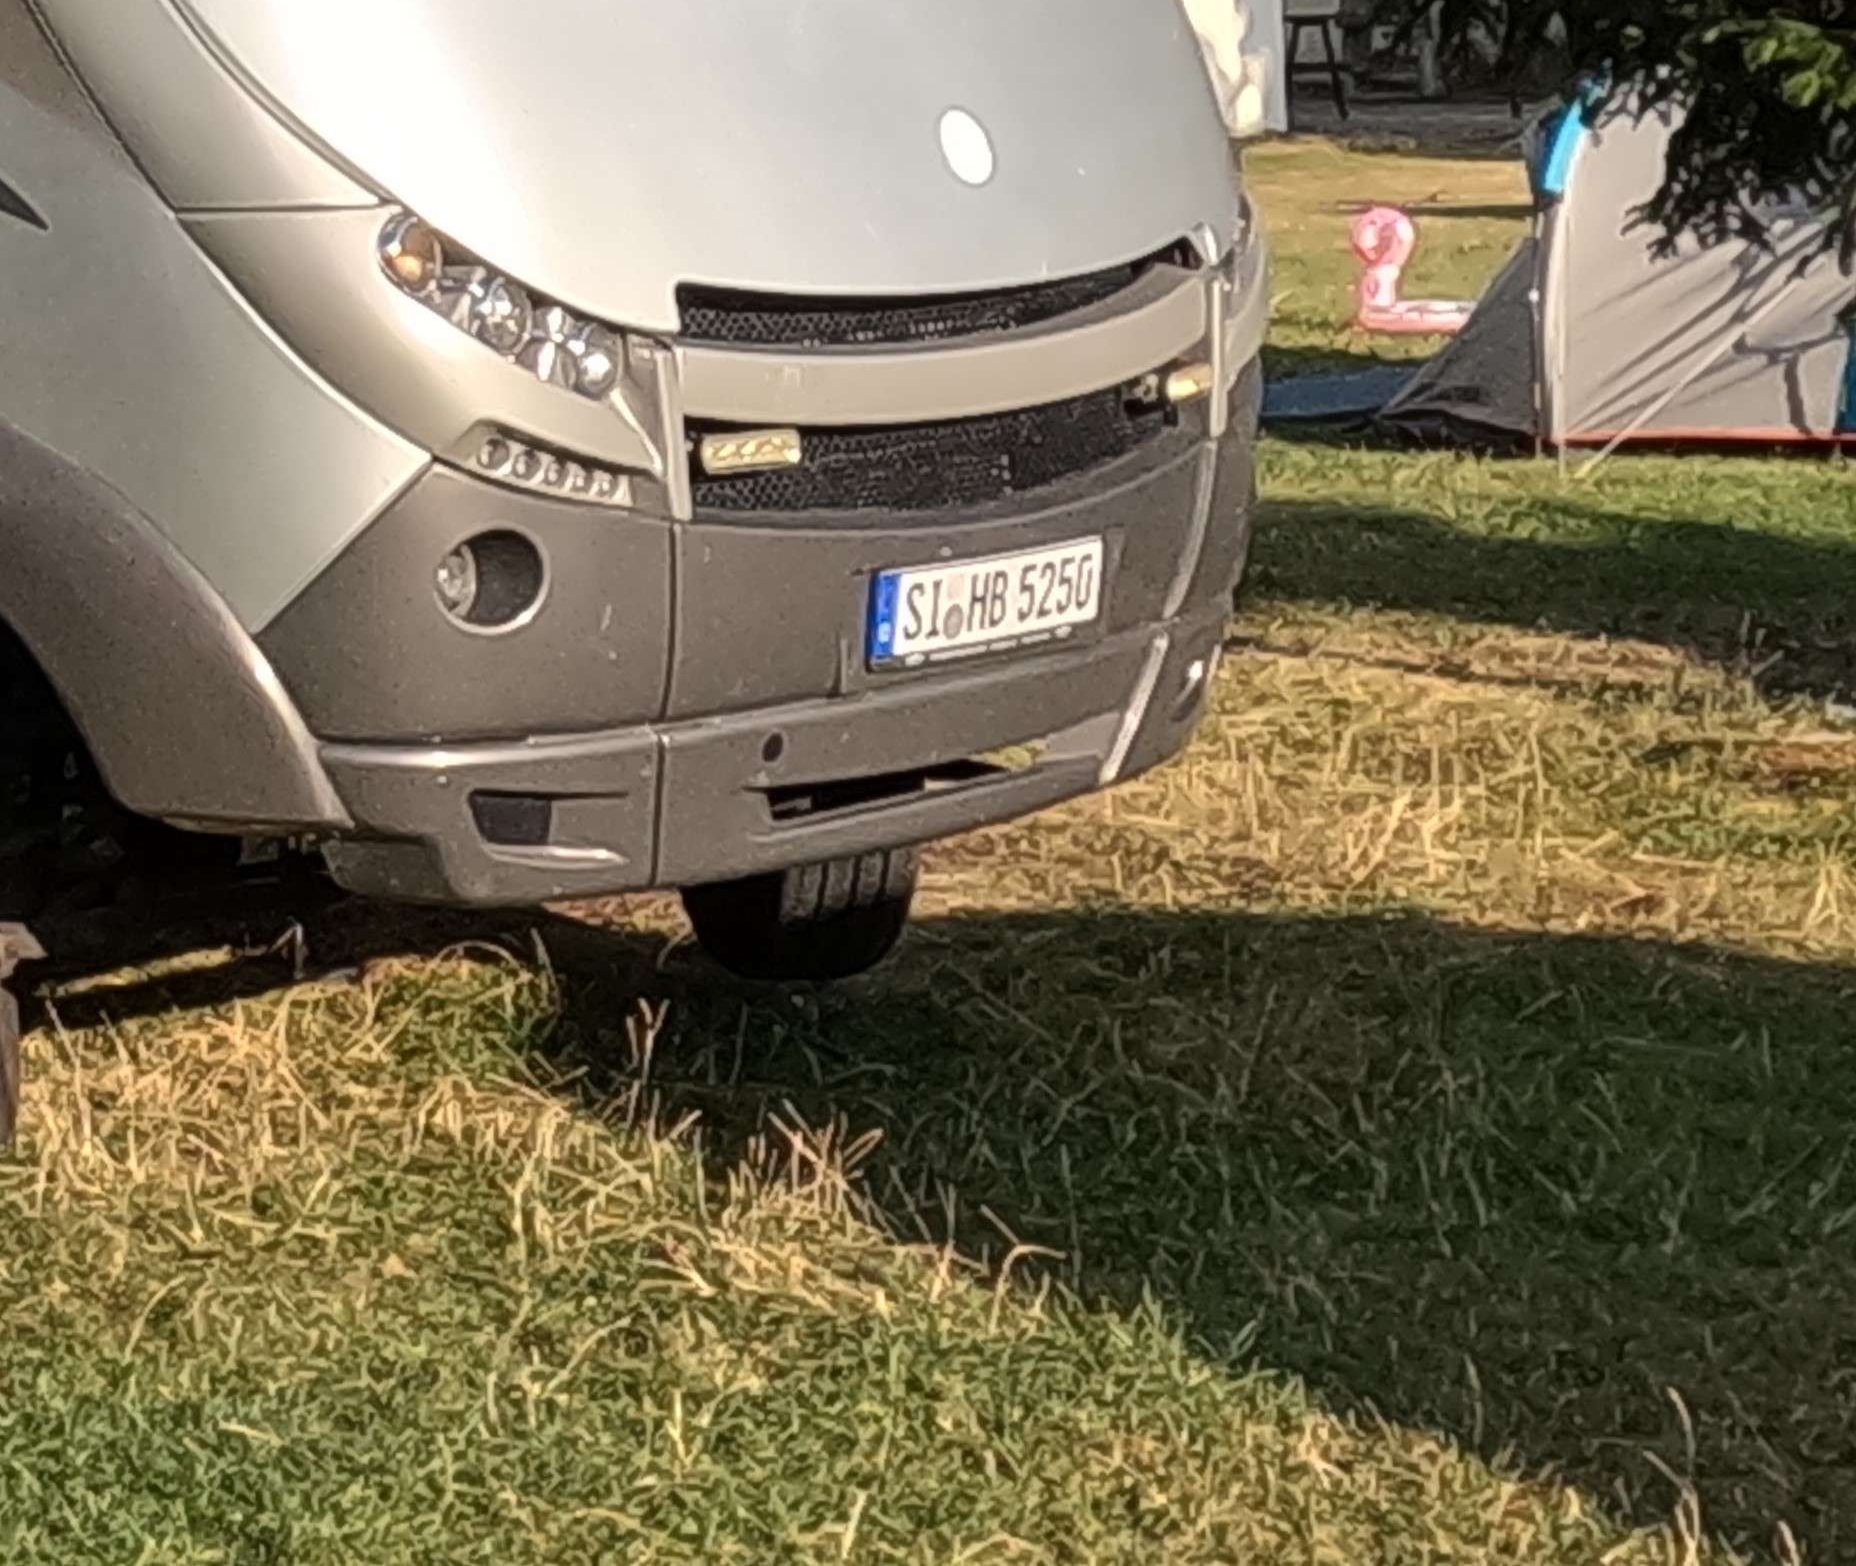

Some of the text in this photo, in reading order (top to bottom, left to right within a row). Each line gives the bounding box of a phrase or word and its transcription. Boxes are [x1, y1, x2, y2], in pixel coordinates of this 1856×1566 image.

[902, 553, 1094, 640] SI HB 5250
